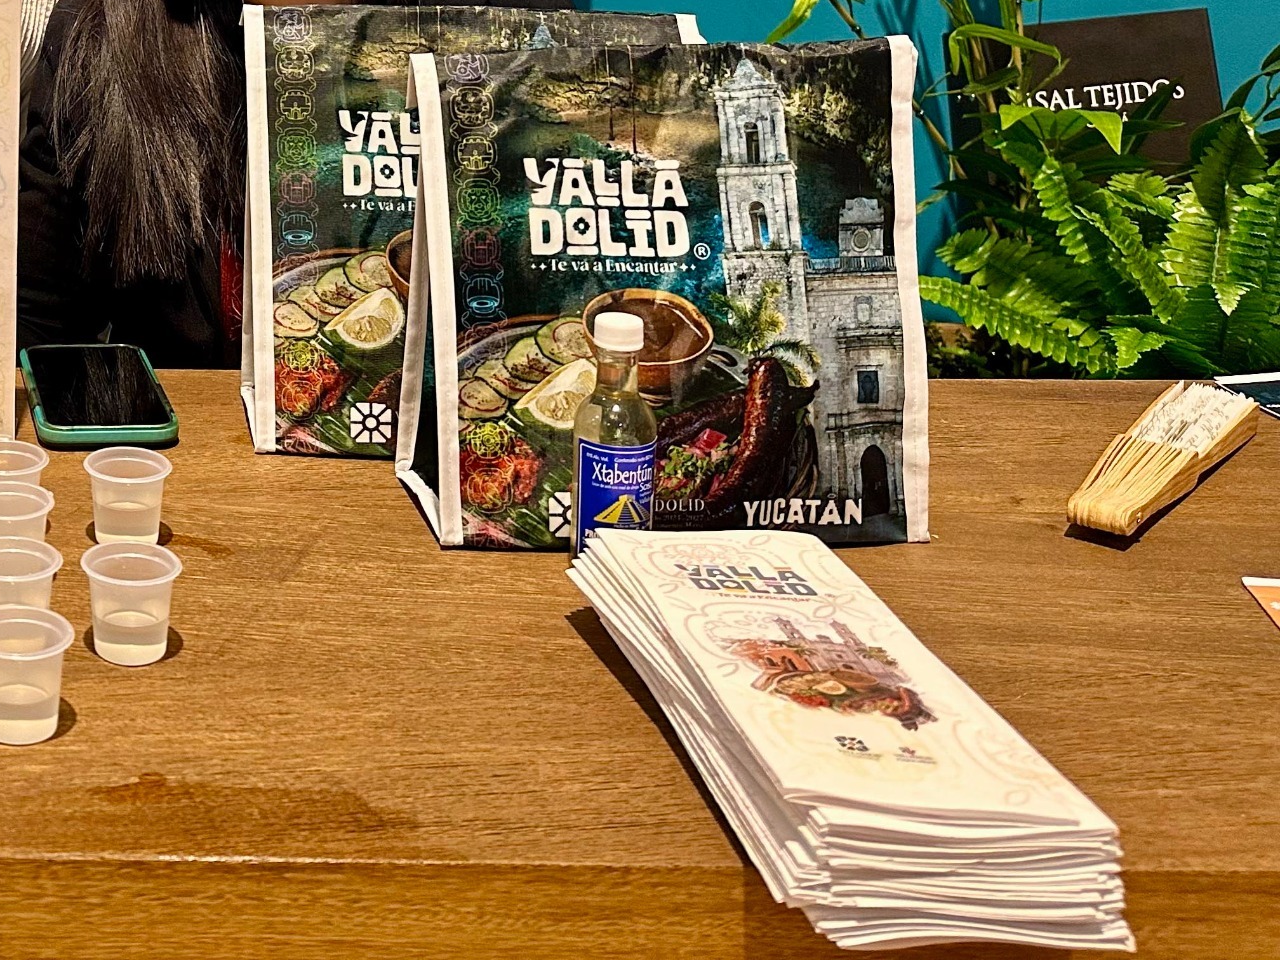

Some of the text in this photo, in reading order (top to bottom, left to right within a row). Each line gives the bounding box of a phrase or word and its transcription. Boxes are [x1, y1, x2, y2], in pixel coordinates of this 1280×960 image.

[339, 110, 421, 155] VAL
[342, 154, 420, 198] DOL
[523, 157, 689, 207] VALLA
[360, 200, 375, 211] Te
[378, 200, 394, 212] va
[396, 203, 405, 212] a
[529, 207, 691, 257] DOLID
[549, 259, 678, 276] Te va a Encantar
[592, 461, 652, 485] Xtabentún
[674, 564, 808, 582] VALLA
[689, 577, 818, 596] DOLID
